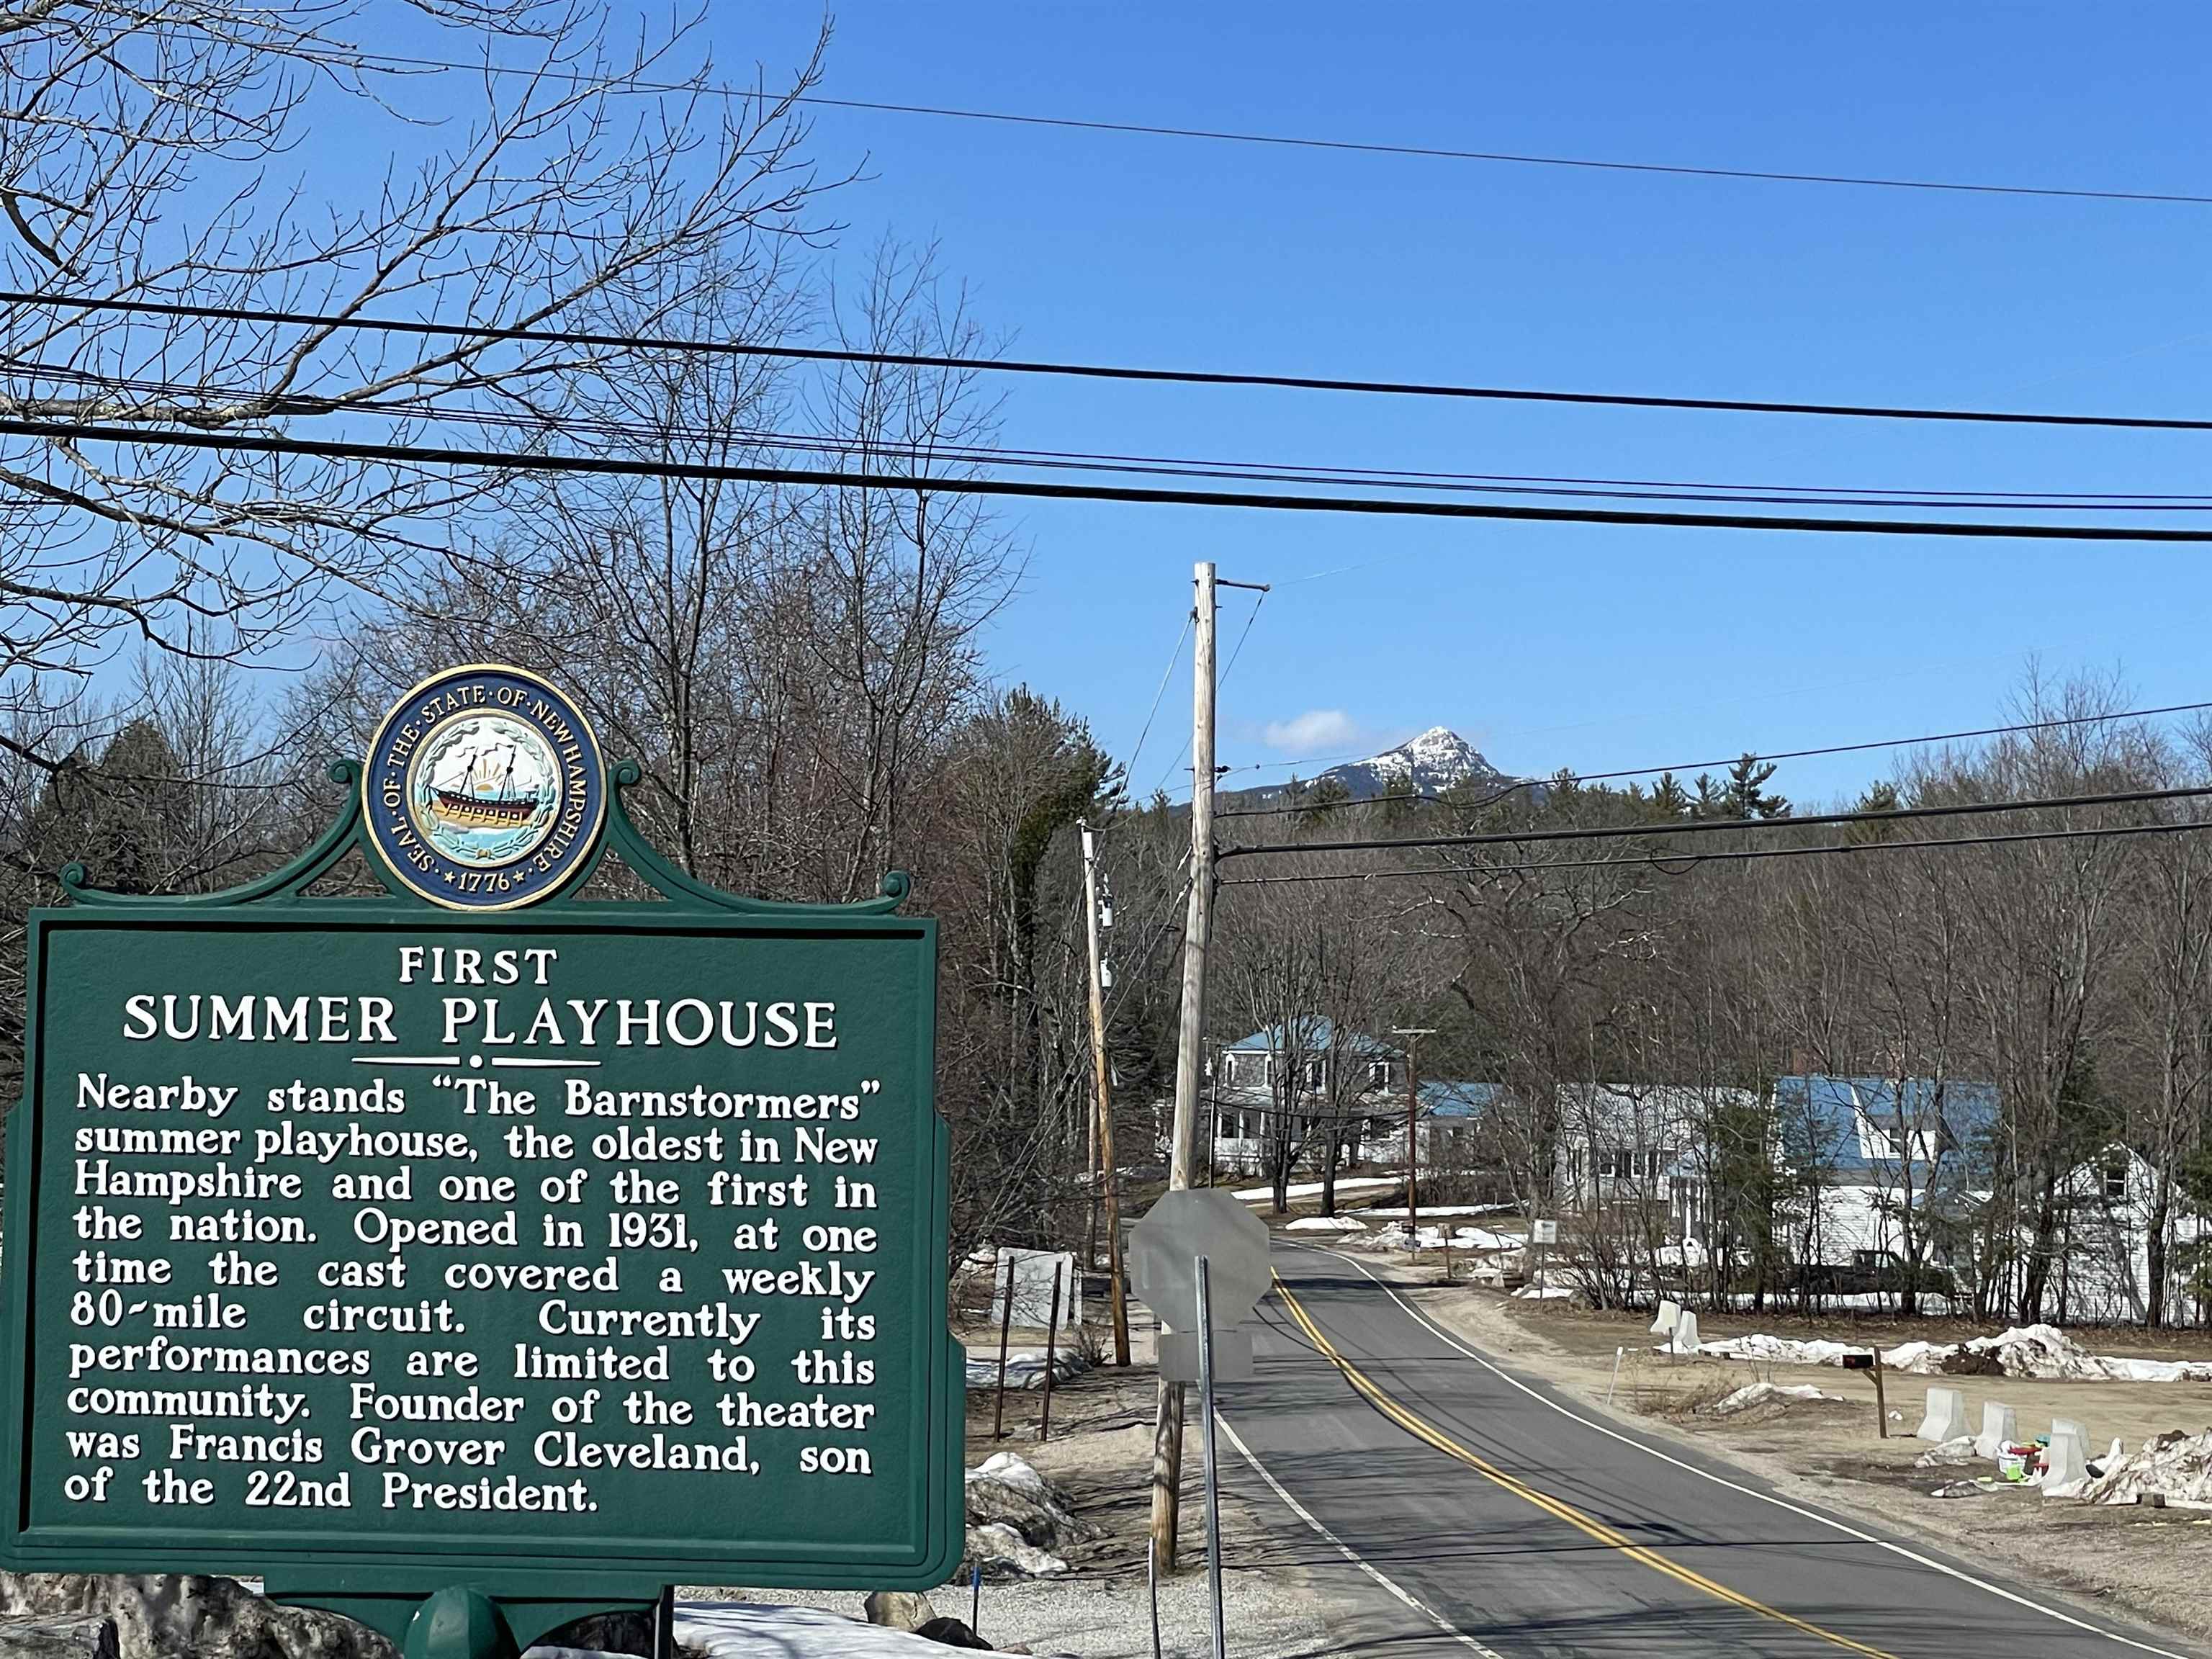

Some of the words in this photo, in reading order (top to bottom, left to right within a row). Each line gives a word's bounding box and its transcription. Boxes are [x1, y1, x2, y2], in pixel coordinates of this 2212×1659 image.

[421, 685, 486, 722] STATE
[497, 687, 528, 707] OF
[530, 701, 574, 744] NEW
[387, 724, 421, 768] THE
[383, 778, 401, 807] OF
[532, 744, 588, 873] HAMPSHIRE
[391, 817, 435, 872] SEAL
[458, 872, 511, 892] 1776
[399, 945, 557, 984] FIRST
[123, 994, 397, 1041] SUMMER
[441, 997, 837, 1048] PLAYHOUSE
[76, 1073, 238, 1118] Nearby
[267, 1078, 405, 1113] stands
[74, 1128, 240, 1154] summer
[254, 1120, 477, 1164] playhouse,
[503, 1125, 574, 1159] the
[592, 1125, 723, 1161] oldest
[739, 1128, 781, 1163] in
[794, 1126, 878, 1164] New
[74, 1159, 302, 1205] Hampshire
[332, 1165, 412, 1200] and
[439, 1176, 516, 1202] one
[540, 1168, 588, 1203] of
[609, 1169, 680, 1204] the
[706, 1170, 808, 1207] first
[835, 1175, 877, 1208] in
[72, 1205, 143, 1239] the
[169, 1208, 316, 1242] nation.
[354, 1207, 518, 1253] Opened
[542, 1213, 584, 1247] in
[608, 1211, 698, 1252] 1931,
[734, 1218, 778, 1250] at
[802, 1225, 877, 1252] one
[72, 1249, 171, 1284] time
[207, 1250, 278, 1286] the
[318, 1255, 406, 1288] cast
[444, 1256, 619, 1291] covered
[659, 1267, 683, 1292] a
[721, 1260, 876, 1303] weekly
[303, 1298, 465, 1333] circuit.
[539, 1299, 761, 1346] Currently
[821, 1306, 876, 1340] its
[68, 1335, 369, 1378] performances
[406, 1351, 478, 1377] are
[513, 1343, 670, 1380] limited
[706, 1349, 755, 1382] to
[791, 1349, 875, 1385] this
[67, 1383, 310, 1424] community.
[350, 1382, 524, 1421] Founder
[552, 1388, 601, 1424] of
[622, 1390, 693, 1425] the
[716, 1392, 875, 1429] theater
[65, 1431, 140, 1459] was
[169, 1423, 323, 1462] Francis
[351, 1426, 505, 1465] Grover
[534, 1431, 760, 1475] Cleveland,
[799, 1447, 871, 1474] son
[64, 1465, 114, 1501] of
[141, 1467, 214, 1504] the
[245, 1470, 351, 1507] 22nd
[382, 1472, 598, 1511] President.
